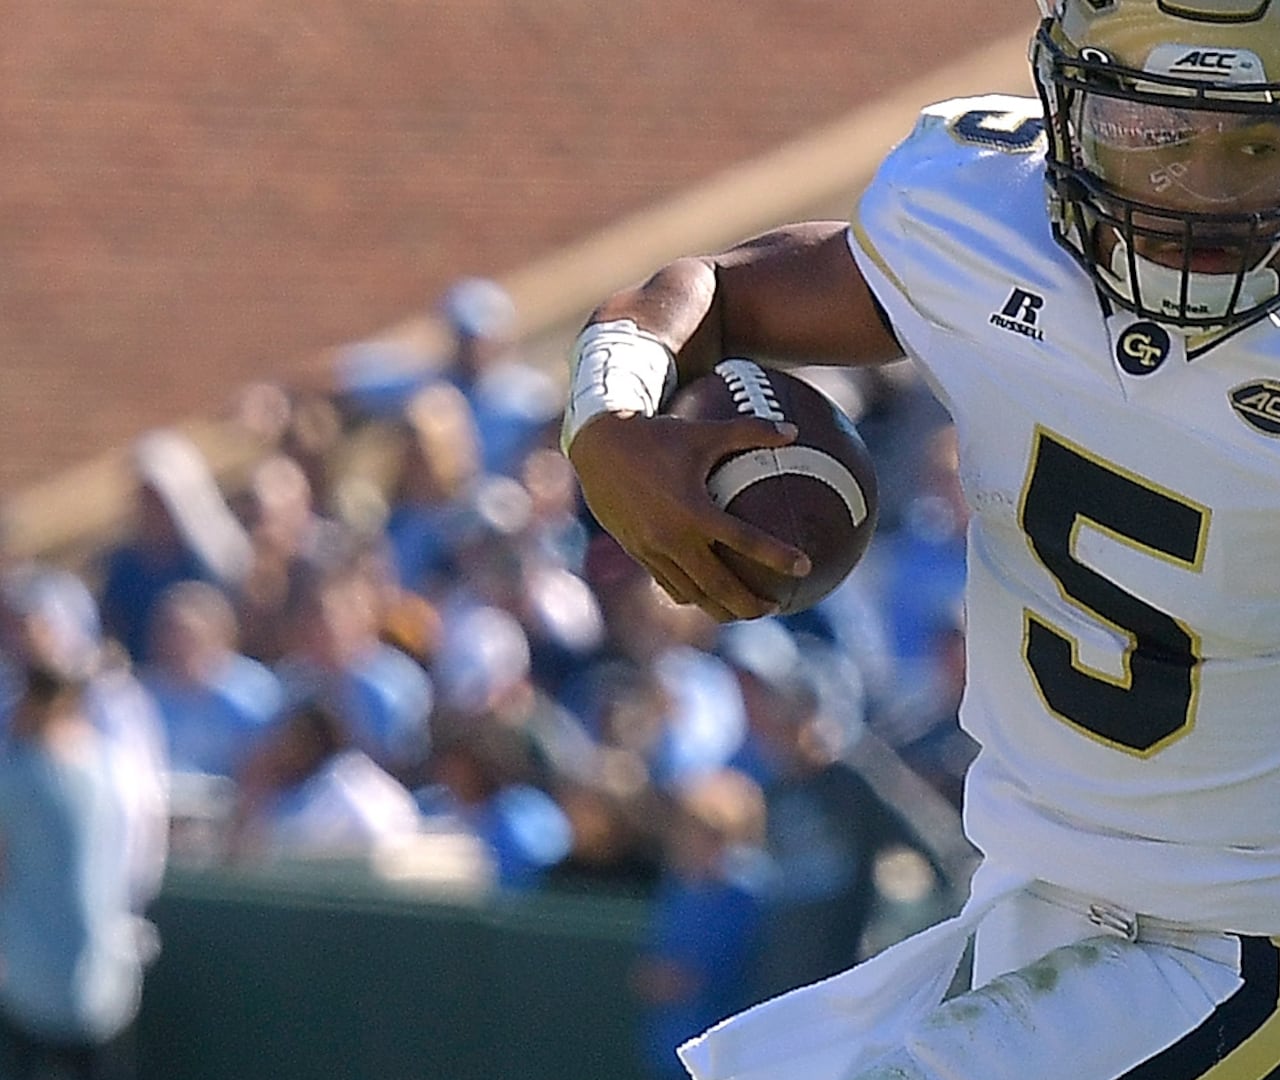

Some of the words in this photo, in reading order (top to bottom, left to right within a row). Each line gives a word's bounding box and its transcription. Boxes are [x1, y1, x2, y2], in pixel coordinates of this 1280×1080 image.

[1174, 51, 1237, 69] ACC
[1000, 287, 1044, 325] R
[989, 313, 1045, 342] RUSSELL
[1123, 332, 1162, 367] GT
[1017, 423, 1213, 760] 5
